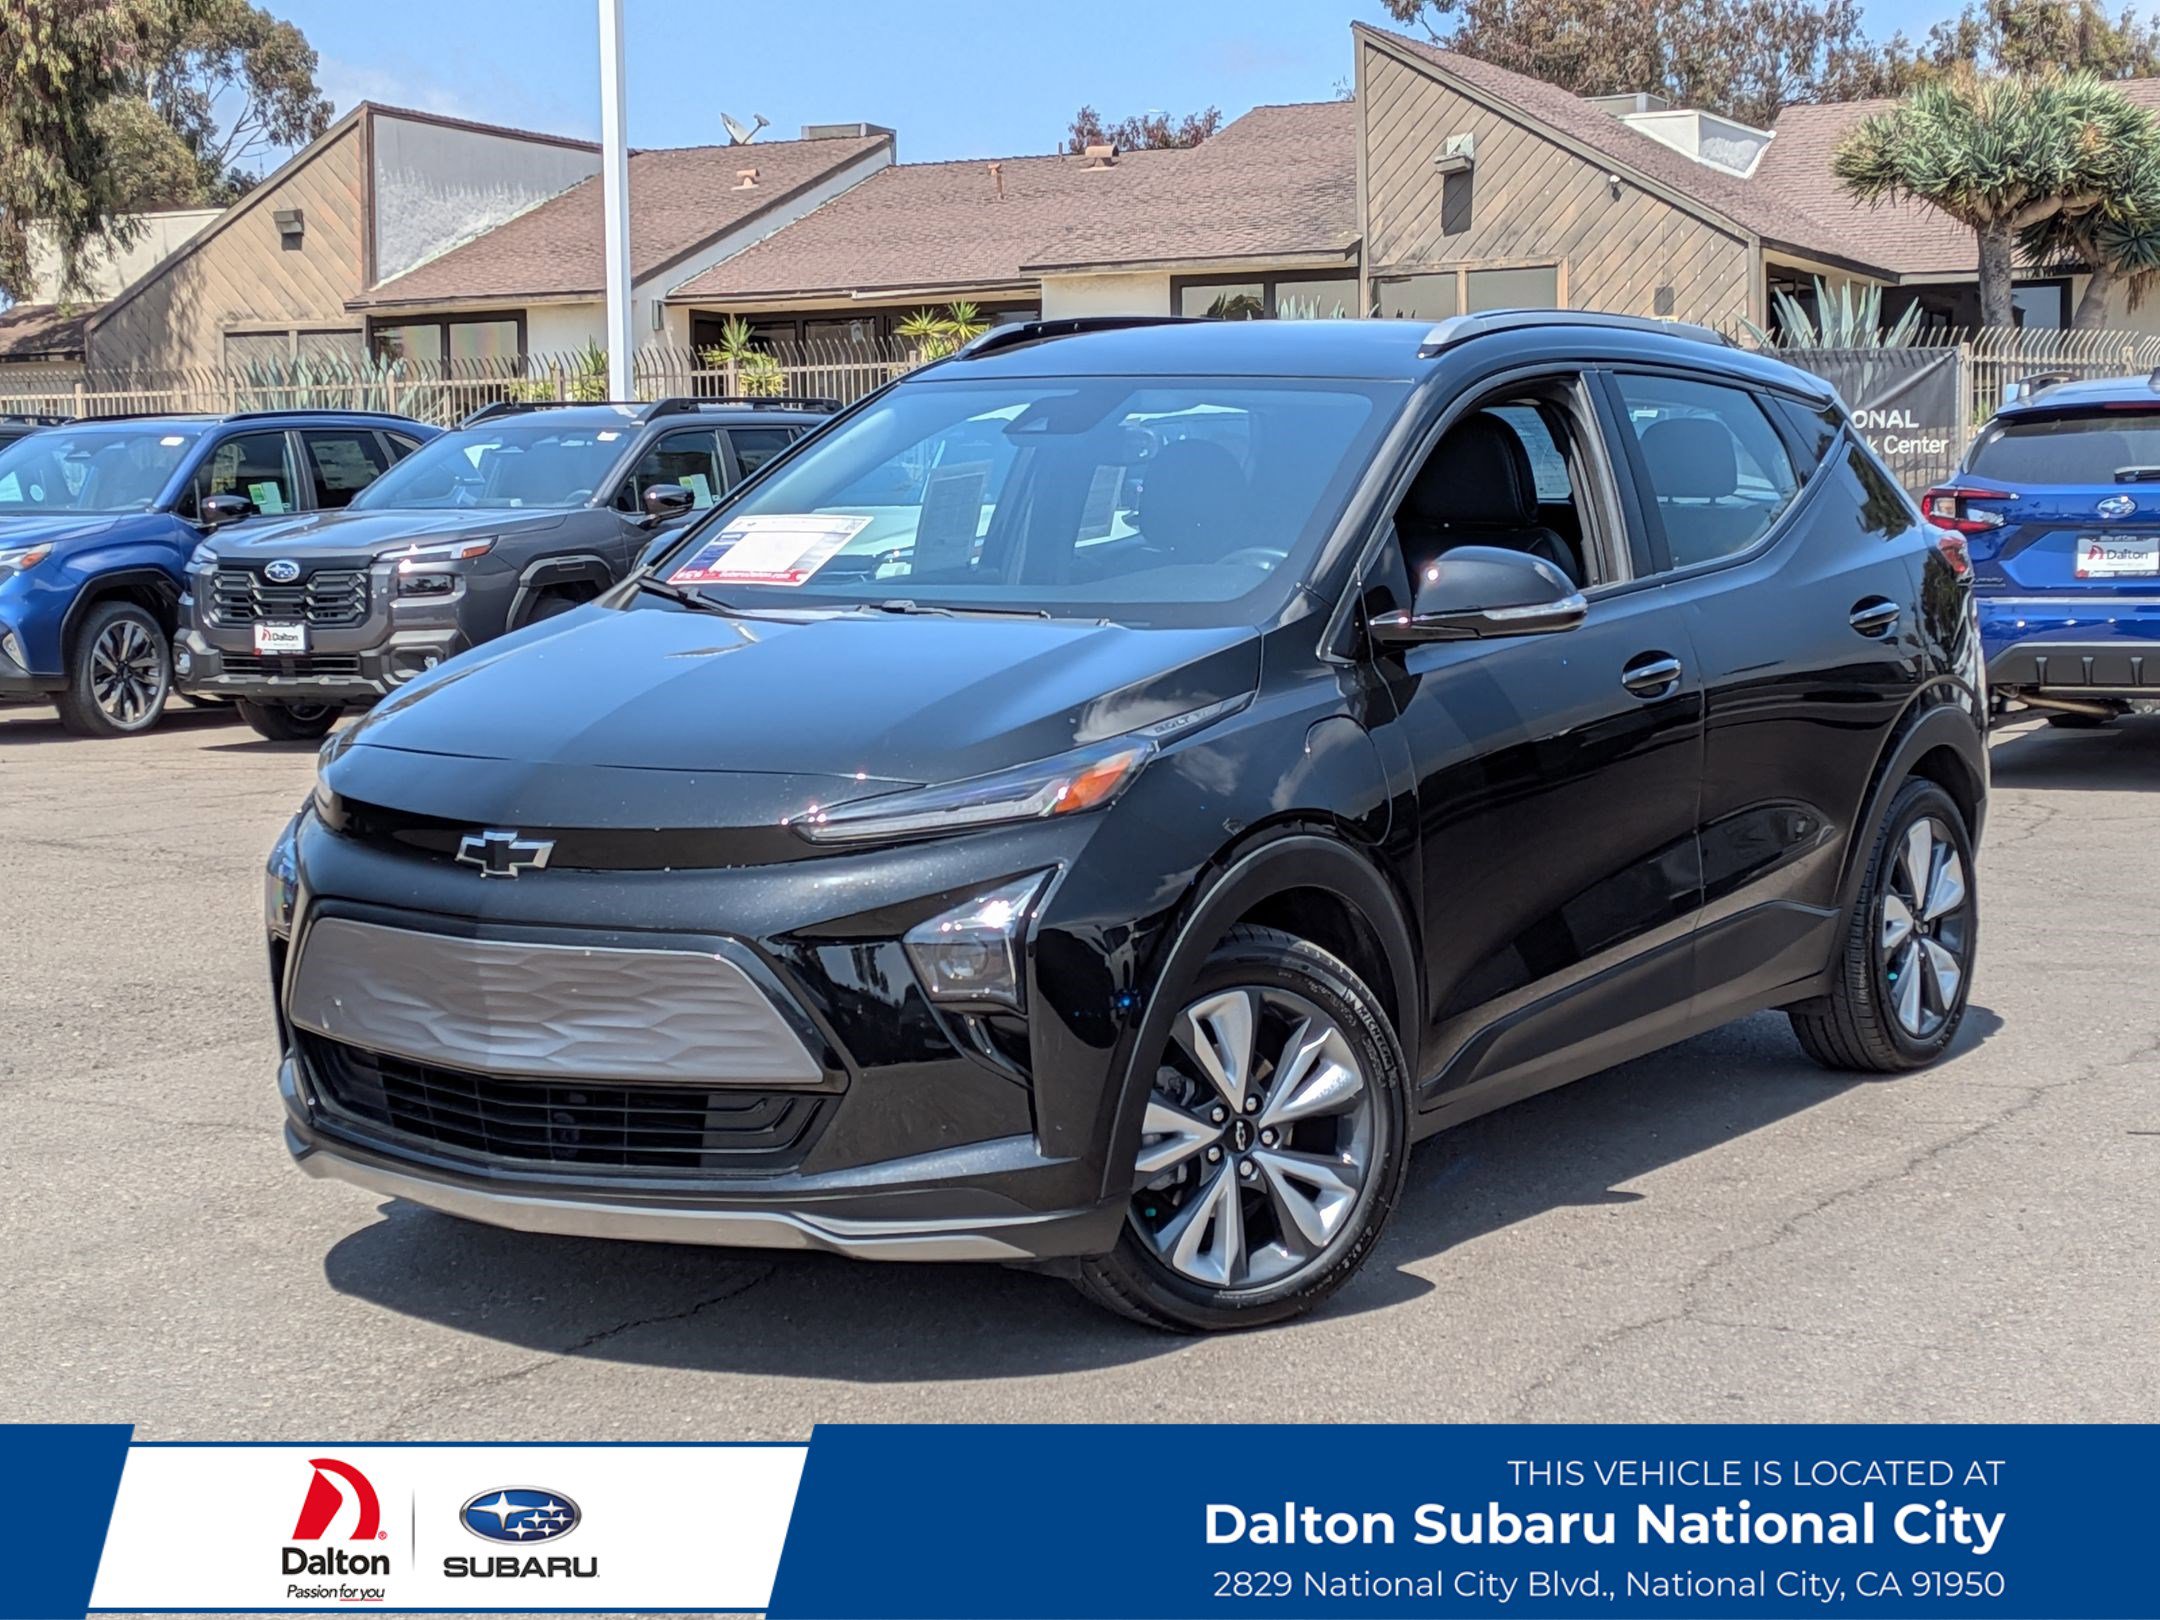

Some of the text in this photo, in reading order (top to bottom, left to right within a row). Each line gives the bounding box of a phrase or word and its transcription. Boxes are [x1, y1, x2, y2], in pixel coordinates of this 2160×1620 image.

[1850, 409, 1920, 430] ONAL
[1883, 434, 1950, 455] Center
[2106, 548, 2149, 560] Dalton
[271, 631, 300, 641] Dalton
